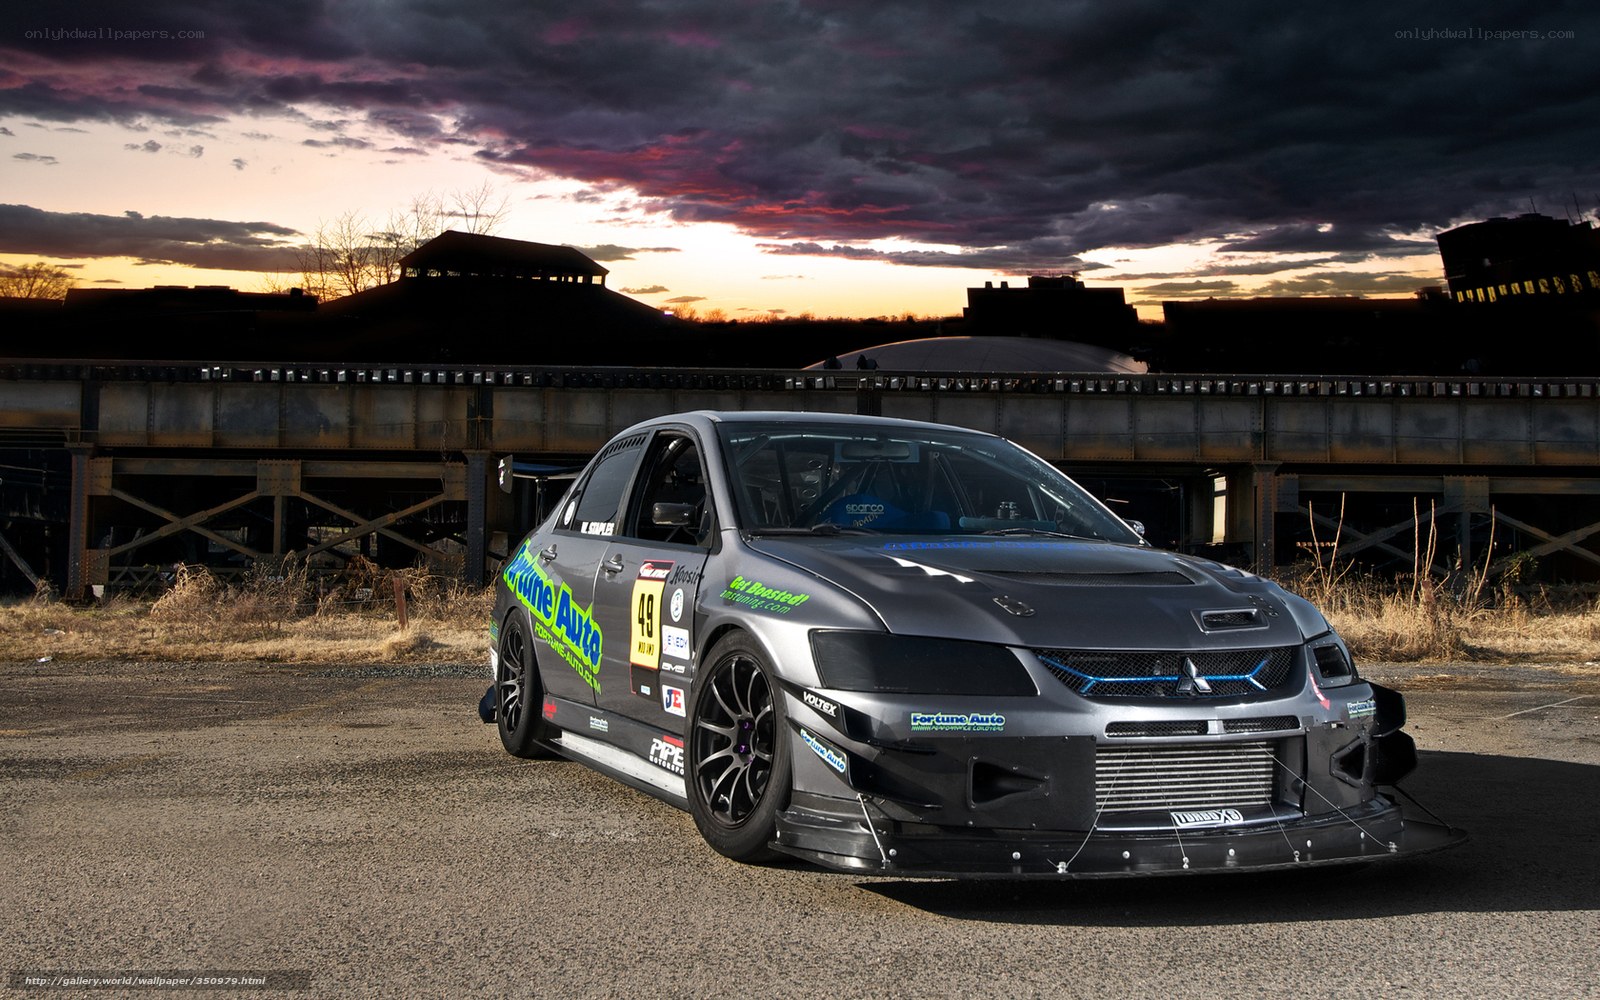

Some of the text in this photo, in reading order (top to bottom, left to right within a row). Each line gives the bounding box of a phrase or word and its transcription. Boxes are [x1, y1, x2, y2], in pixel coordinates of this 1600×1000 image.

[845, 503, 885, 514] sparco
[730, 575, 810, 607] Get Boosted!
[503, 539, 603, 674] Fortune Auto
[638, 593, 654, 638] 49
[665, 688, 682, 709] JE
[803, 691, 838, 717] VOLTEX
[911, 712, 1006, 726] Fortune Auto
[649, 754, 685, 776] MOTORSPO
[650, 738, 685, 768] PIPE
[825, 749, 847, 773] Auto
